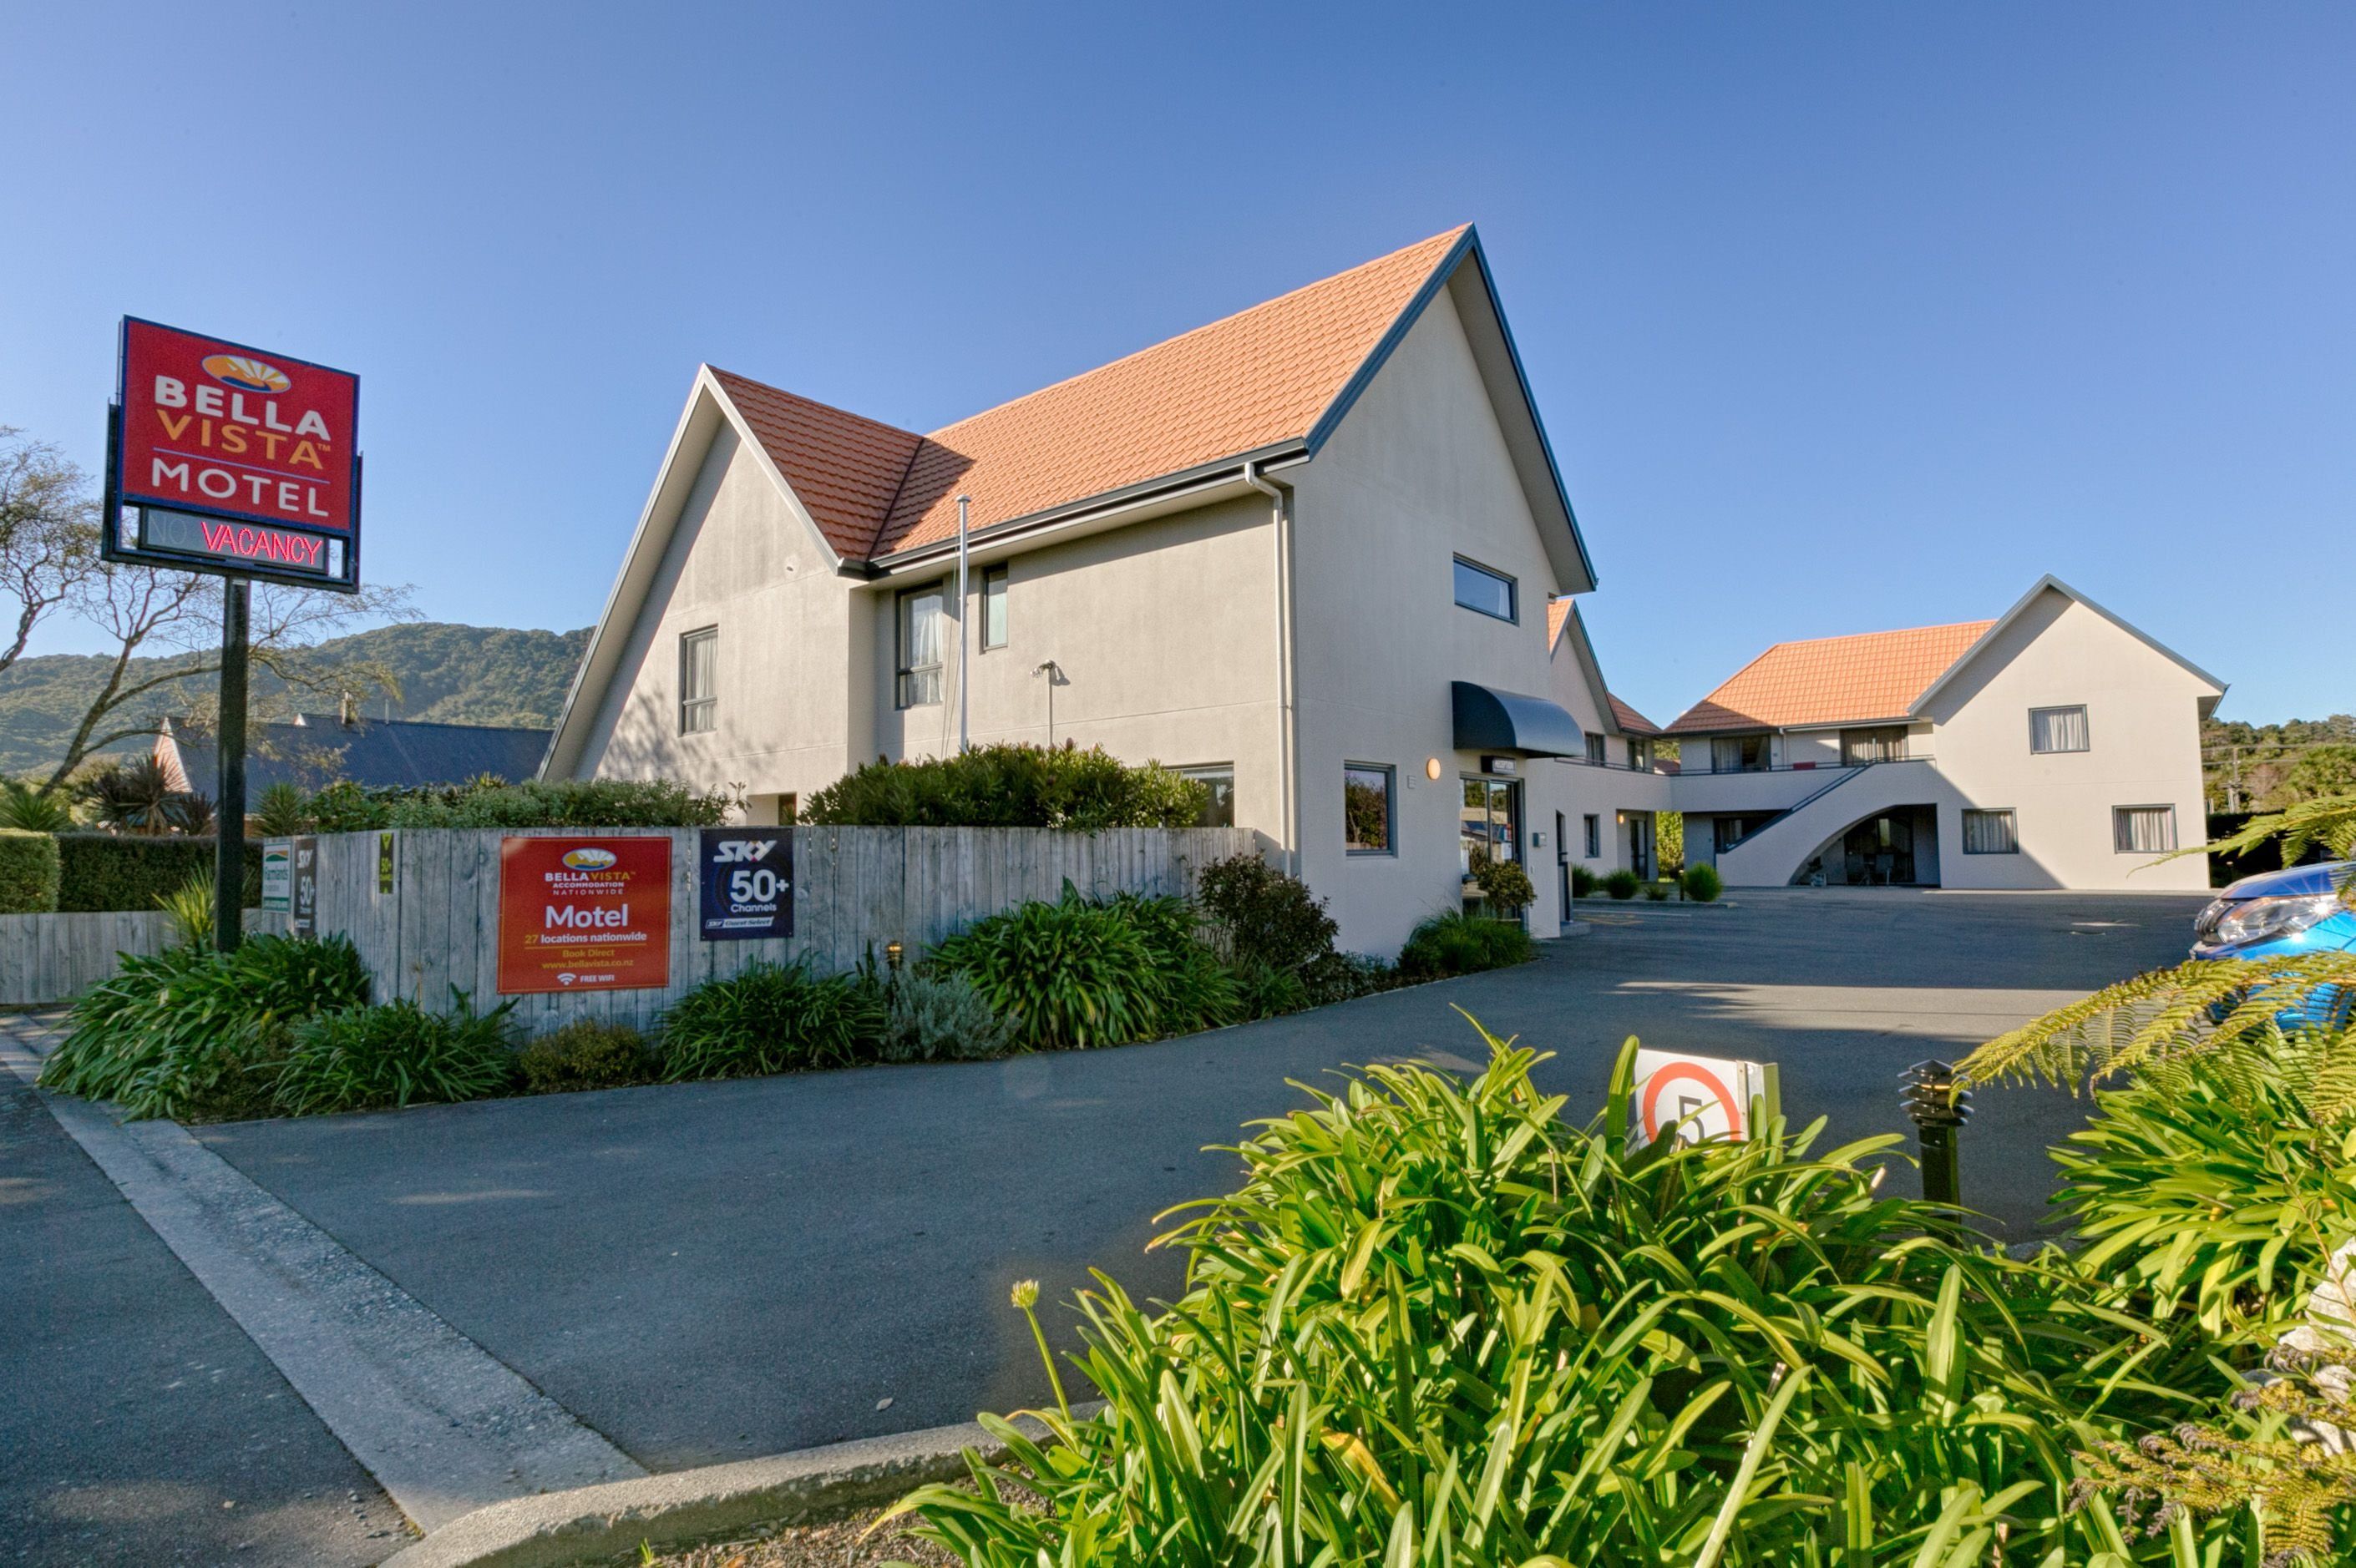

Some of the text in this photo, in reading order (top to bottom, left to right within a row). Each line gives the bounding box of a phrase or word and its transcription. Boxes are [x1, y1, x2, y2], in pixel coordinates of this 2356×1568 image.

[155, 375, 331, 442] BELLA
[155, 409, 324, 470] VISTA
[151, 458, 329, 517] MOTEL
[201, 521, 322, 565] VACANCY
[712, 839, 778, 863] SKY
[729, 869, 790, 903] 50+
[545, 903, 629, 929] Motel
[731, 903, 777, 913] Channels
[524, 931, 647, 945] 27 locations nationwide
[541, 959, 634, 969] www.bellavista.co.nz
[562, 948, 616, 958] Book Direct
[580, 974, 597, 983] FREE
